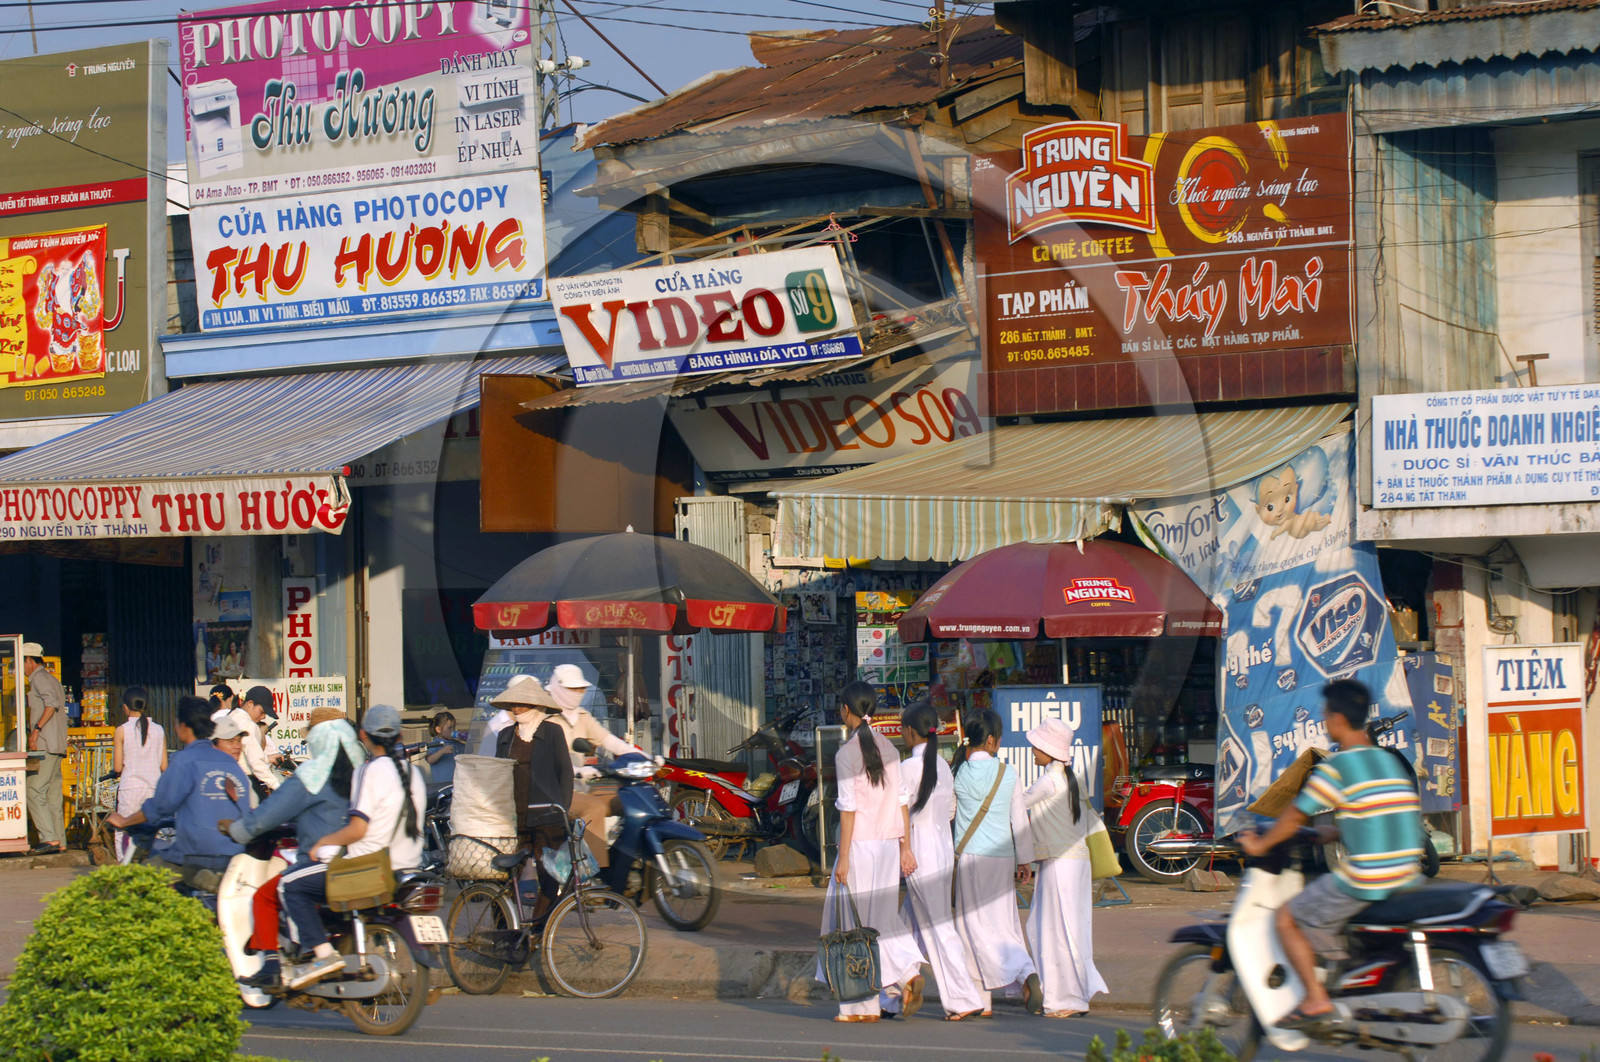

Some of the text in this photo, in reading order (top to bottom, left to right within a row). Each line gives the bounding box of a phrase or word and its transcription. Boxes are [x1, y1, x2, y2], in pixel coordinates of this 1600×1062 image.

[193, 0, 459, 68] PHOTOCOPY
[83, 65, 106, 75] TRUNG
[440, 45, 518, 75] ĐÁNH MÁY
[465, 77, 519, 102] VI TÍNH
[251, 69, 435, 154] Thu Hương
[455, 109, 521, 133] IN LASER
[458, 137, 523, 163] ÉP NHỰA
[206, 187, 223, 198] Ama
[224, 185, 242, 197] Jhao
[262, 180, 279, 192] BMT
[307, 171, 350, 187] 050.866352
[357, 169, 385, 182] 956065
[391, 162, 437, 178] 0914032031
[1014, 135, 1140, 225] TRUNG NGUYÊN
[1256, 177, 1292, 207] sáng
[1295, 167, 1319, 197] tạo
[80, 193, 89, 201] MA
[218, 184, 508, 239] CỬA HÀNG PHOTOCOPY
[206, 218, 527, 309] THU HƯƠNG
[655, 268, 743, 293] CỬA HÀNG
[805, 272, 834, 325] 9
[998, 279, 1090, 318] TẠP PHẨM
[1114, 255, 1325, 340] Thúy Mai
[260, 306, 274, 321] VI
[560, 287, 786, 371] VIDEO
[1121, 338, 1139, 354] BÁN
[1177, 334, 1197, 349] CÁC
[1224, 331, 1250, 346] HÀNG
[1251, 330, 1270, 346] TẠP
[116, 349, 140, 374] LOẠI
[724, 350, 753, 366] HÌNH
[781, 345, 807, 359] VCD
[62, 385, 106, 400] 865248
[1427, 396, 1448, 407] CÔNG
[1450, 396, 1459, 406] TY
[1561, 391, 1567, 400] Y
[714, 392, 897, 461] VIDEO
[1384, 413, 1419, 450] NHÀ
[1424, 409, 1482, 450] THUỐC
[1487, 412, 1545, 447] DOANH
[392, 459, 438, 477] 866352
[1403, 456, 1450, 472] DƯỢC
[1481, 453, 1519, 467] VĂN
[1526, 449, 1572, 465] THÚC
[1387, 475, 1403, 488] BÁN
[1418, 473, 1449, 487] THUỐC
[1453, 472, 1482, 487] THÀNH
[1525, 472, 1549, 486] DỤNG
[1564, 472, 1571, 482] Y
[1573, 469, 1584, 482] TẾ
[0, 480, 348, 532] HOTOCOPPY THU HƯƠG
[1419, 488, 1467, 502] TẤT THÀNH
[20, 519, 148, 537] NGUYỄN TẤT THÀNH
[1066, 579, 1131, 601] TRUNG NGUYÊN
[1496, 649, 1567, 697] TIỆM
[289, 681, 343, 694] GIẤY KHAI SINH
[1488, 713, 1580, 821] VÀNG
